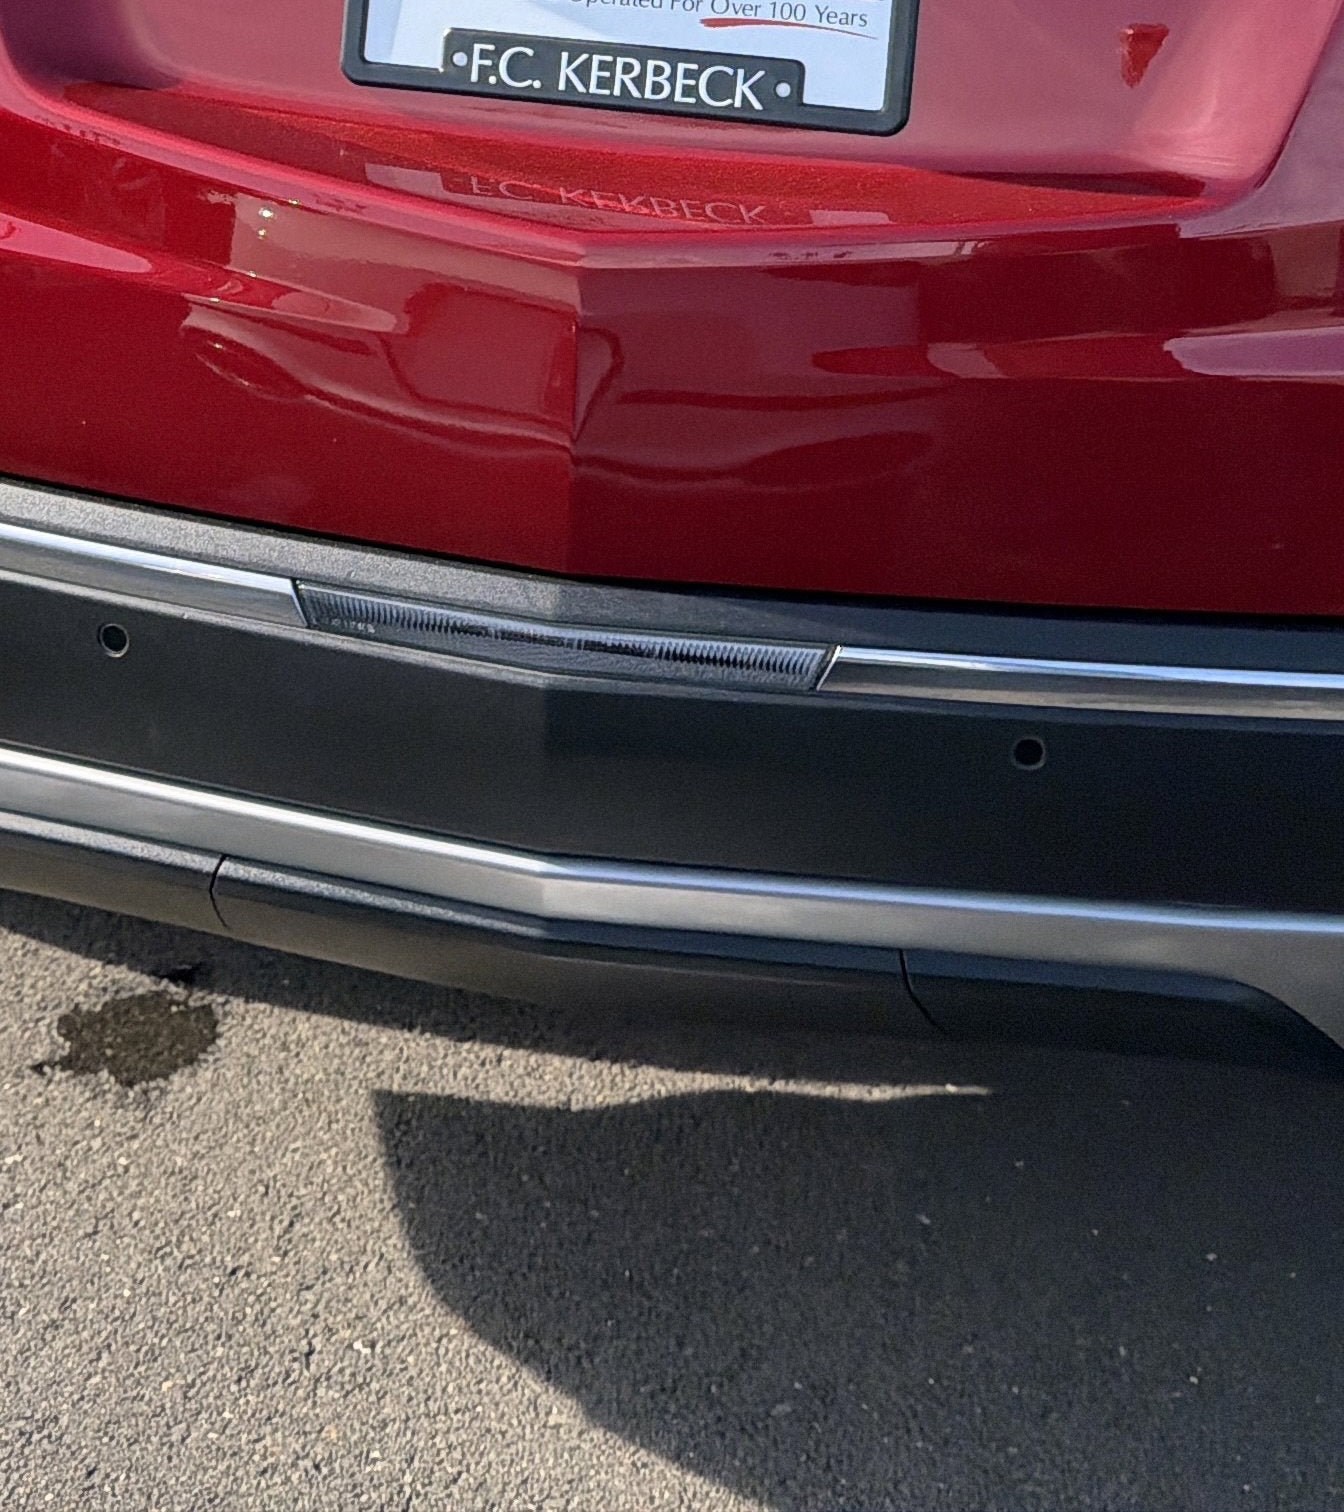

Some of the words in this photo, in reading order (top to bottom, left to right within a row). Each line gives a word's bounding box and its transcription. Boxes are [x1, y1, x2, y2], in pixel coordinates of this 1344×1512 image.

[769, 0, 807, 22] 100
[814, 5, 869, 29] Years
[469, 44, 543, 90] F.C.
[558, 52, 767, 110] KERBECK
